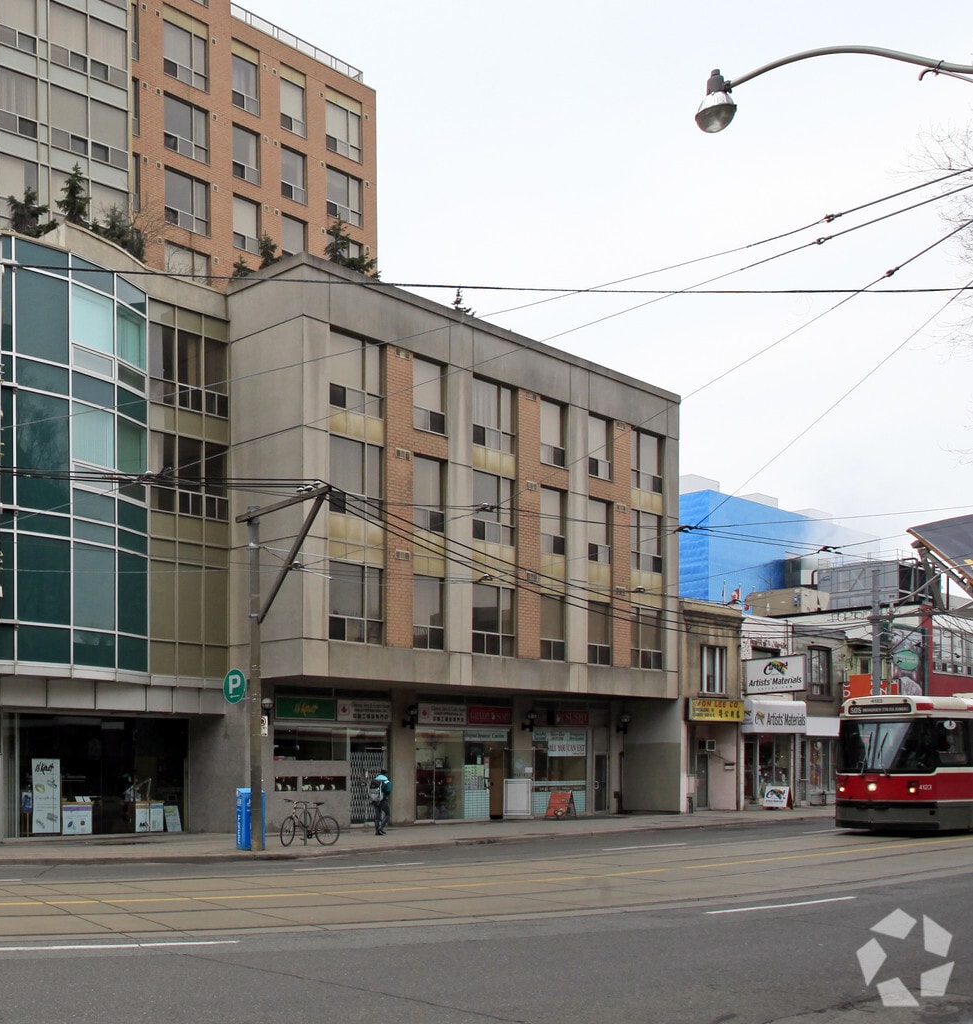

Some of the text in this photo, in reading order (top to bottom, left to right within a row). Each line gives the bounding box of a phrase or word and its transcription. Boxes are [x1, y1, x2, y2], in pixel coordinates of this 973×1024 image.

[229, 675, 241, 695] P
[748, 675, 802, 687] Artists' Materials
[767, 713, 784, 726] Artists'
[784, 713, 806, 726] Materials
